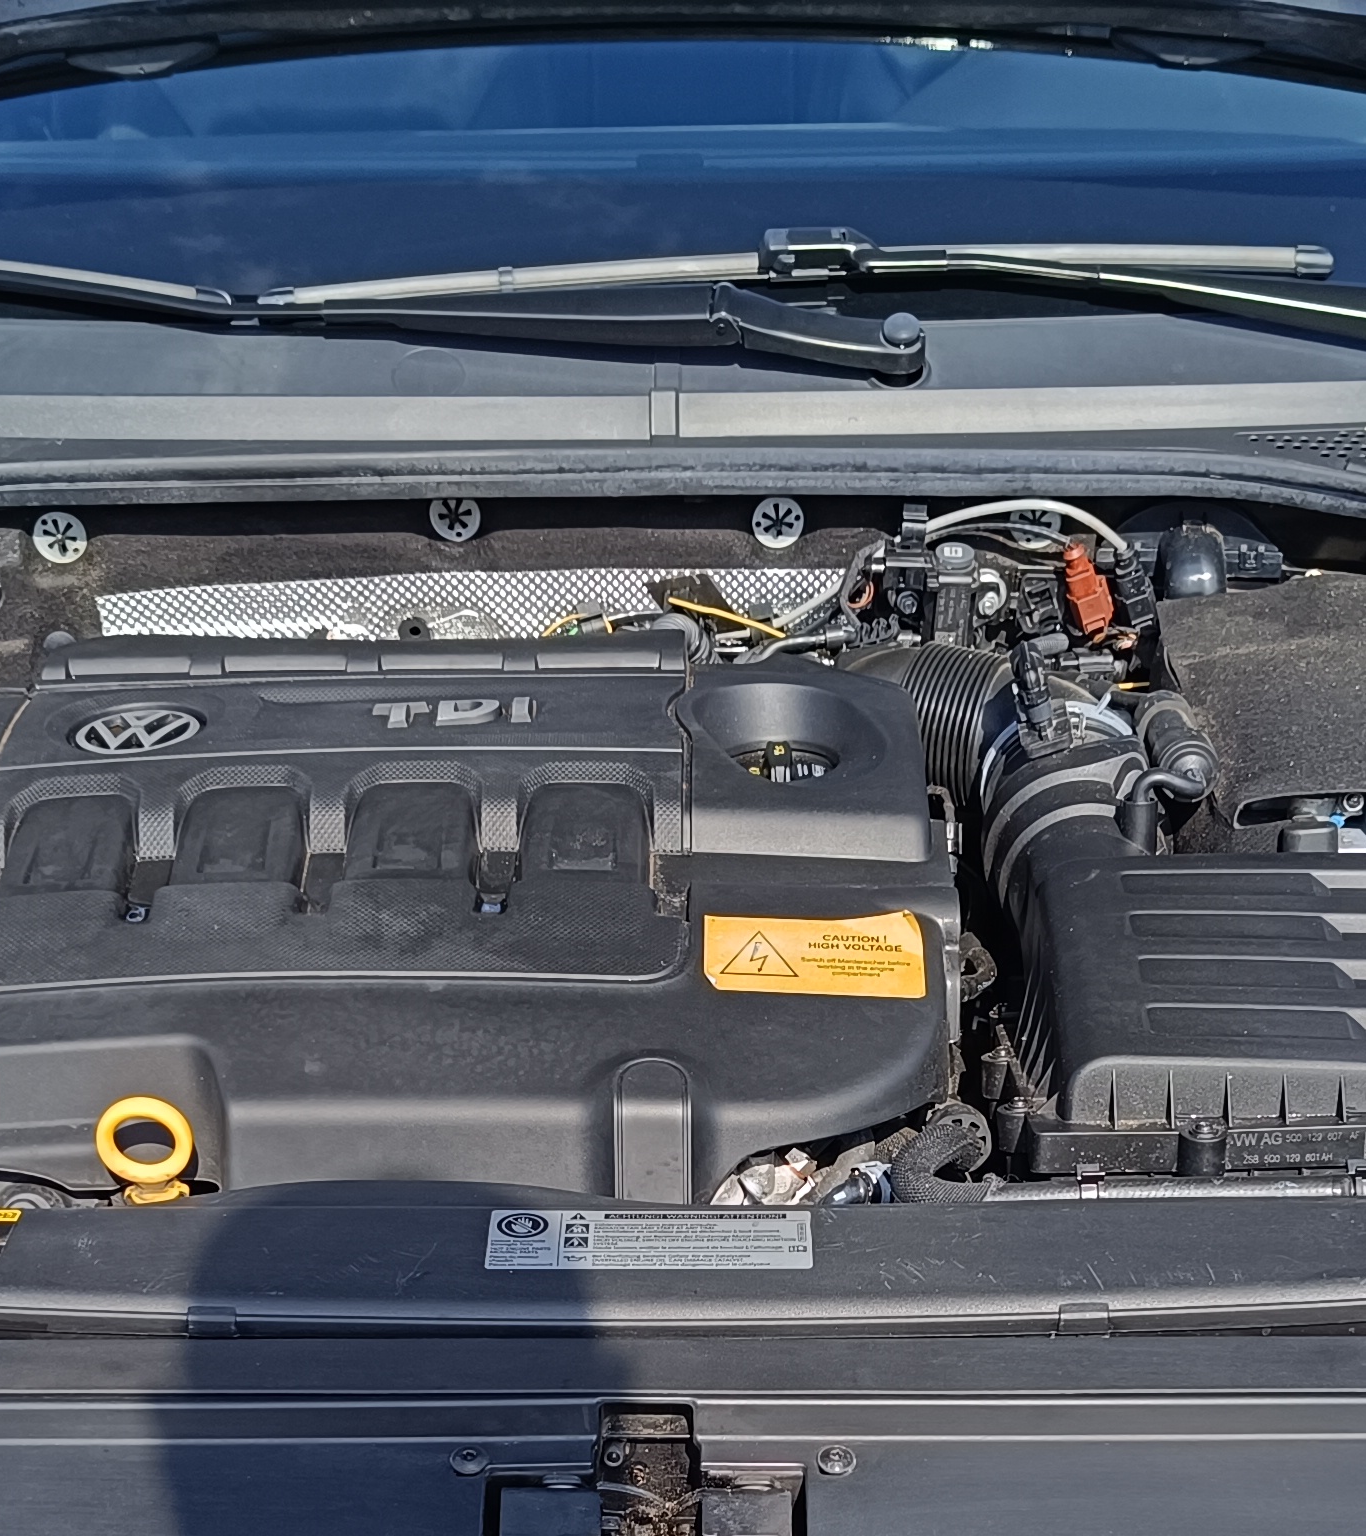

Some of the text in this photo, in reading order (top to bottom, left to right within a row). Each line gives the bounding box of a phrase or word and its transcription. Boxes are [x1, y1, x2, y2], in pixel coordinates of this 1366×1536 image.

[372, 696, 538, 729] TDI
[822, 934, 879, 943] CAUTION
[808, 942, 903, 952] HIGH VOLTAGE
[1234, 1133, 1258, 1147] VW
[1260, 1132, 1283, 1146] AG
